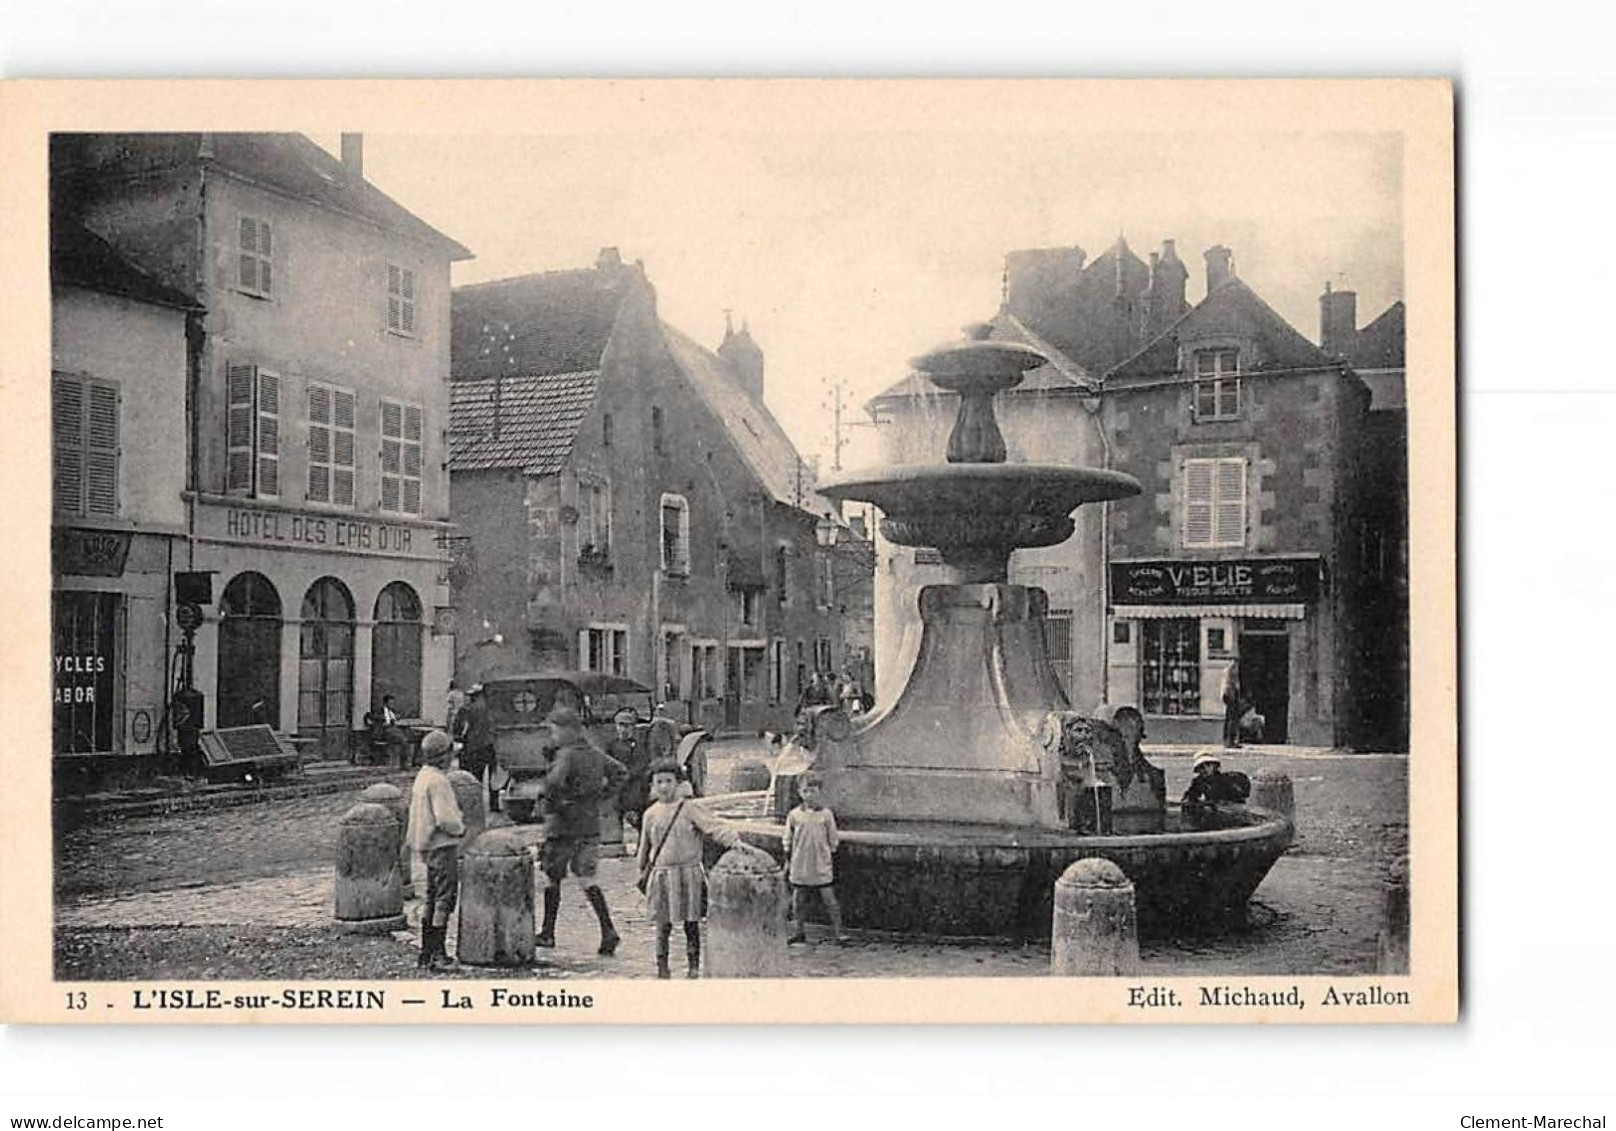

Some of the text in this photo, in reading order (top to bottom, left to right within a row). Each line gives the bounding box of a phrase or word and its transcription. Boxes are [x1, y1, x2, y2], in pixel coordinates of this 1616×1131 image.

[228, 509, 285, 541] HOTEL
[293, 516, 327, 545] DES
[1192, 565, 1253, 587] ELIE
[55, 655, 104, 673] YCLES
[54, 686, 96, 703] ABOR
